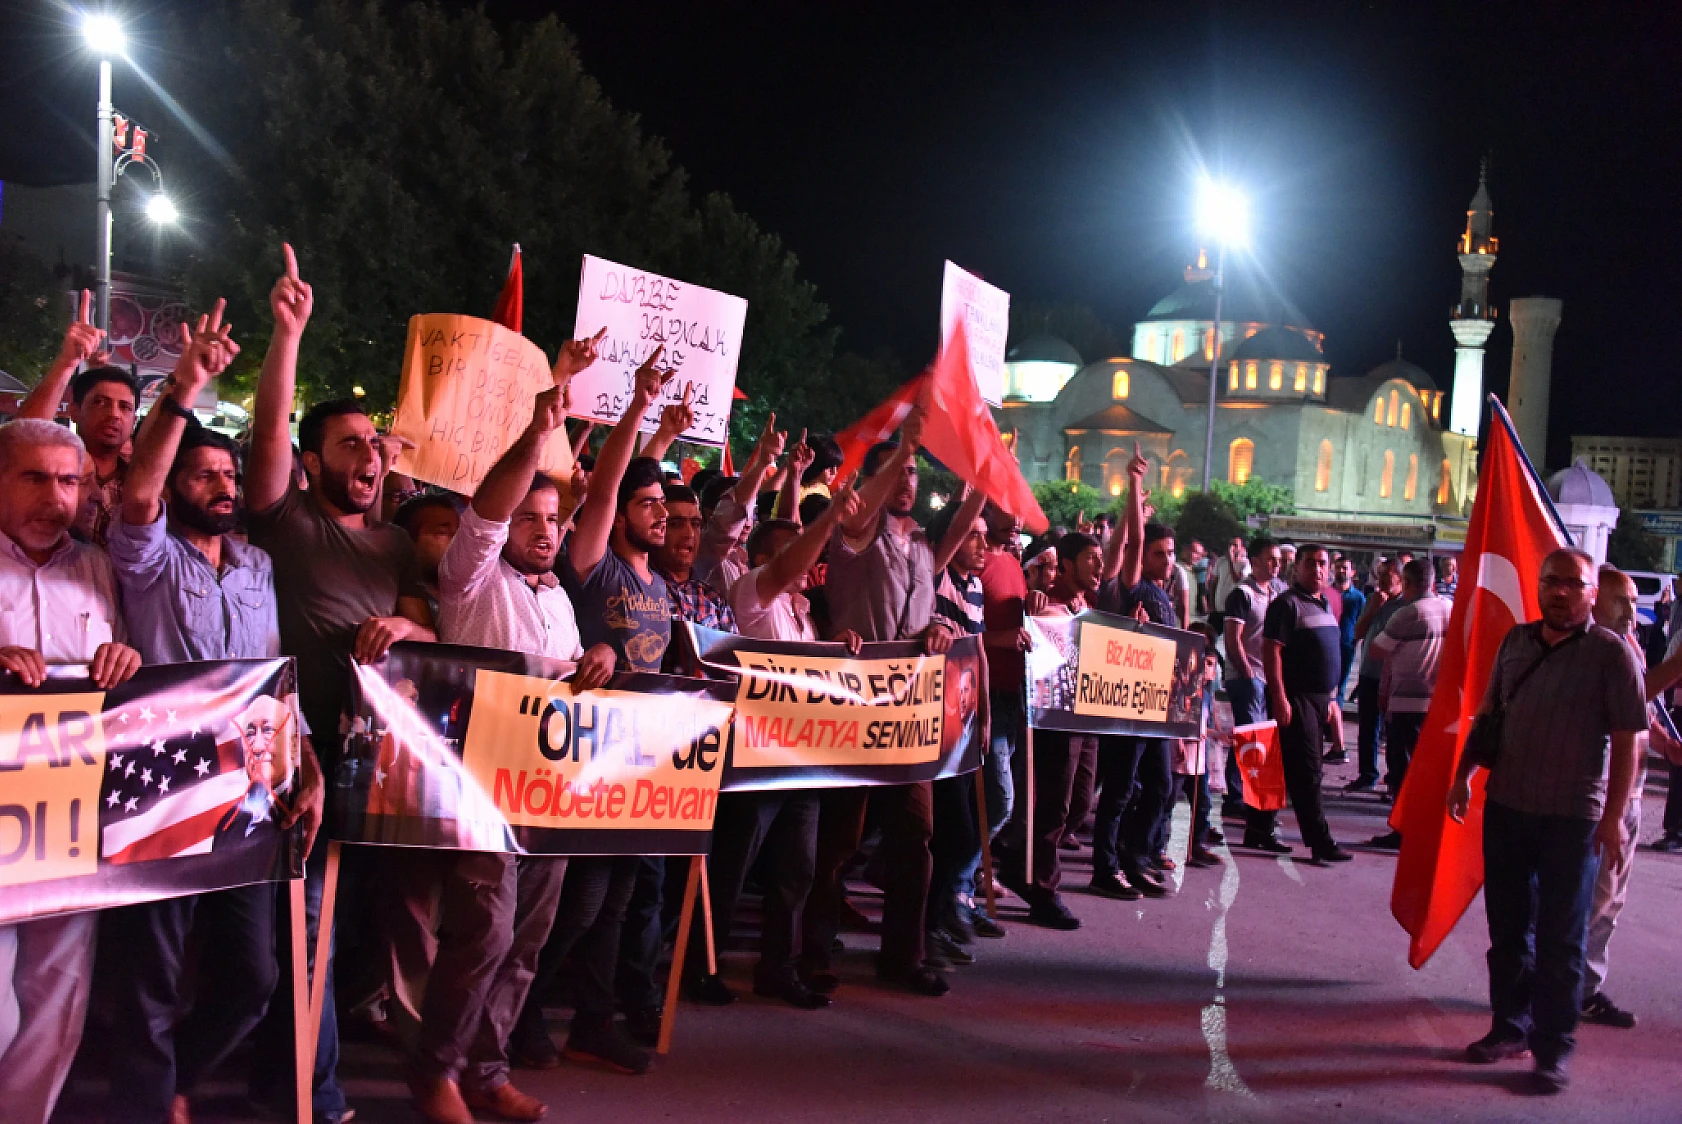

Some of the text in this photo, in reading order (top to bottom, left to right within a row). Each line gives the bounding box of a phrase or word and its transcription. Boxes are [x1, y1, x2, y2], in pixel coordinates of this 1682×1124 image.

[1106, 639, 1157, 671] Biz Ancak
[1079, 672, 1129, 704] Rükuda
[744, 712, 940, 749] MALATYA SENİNLE
[493, 767, 626, 819] Nöbete
